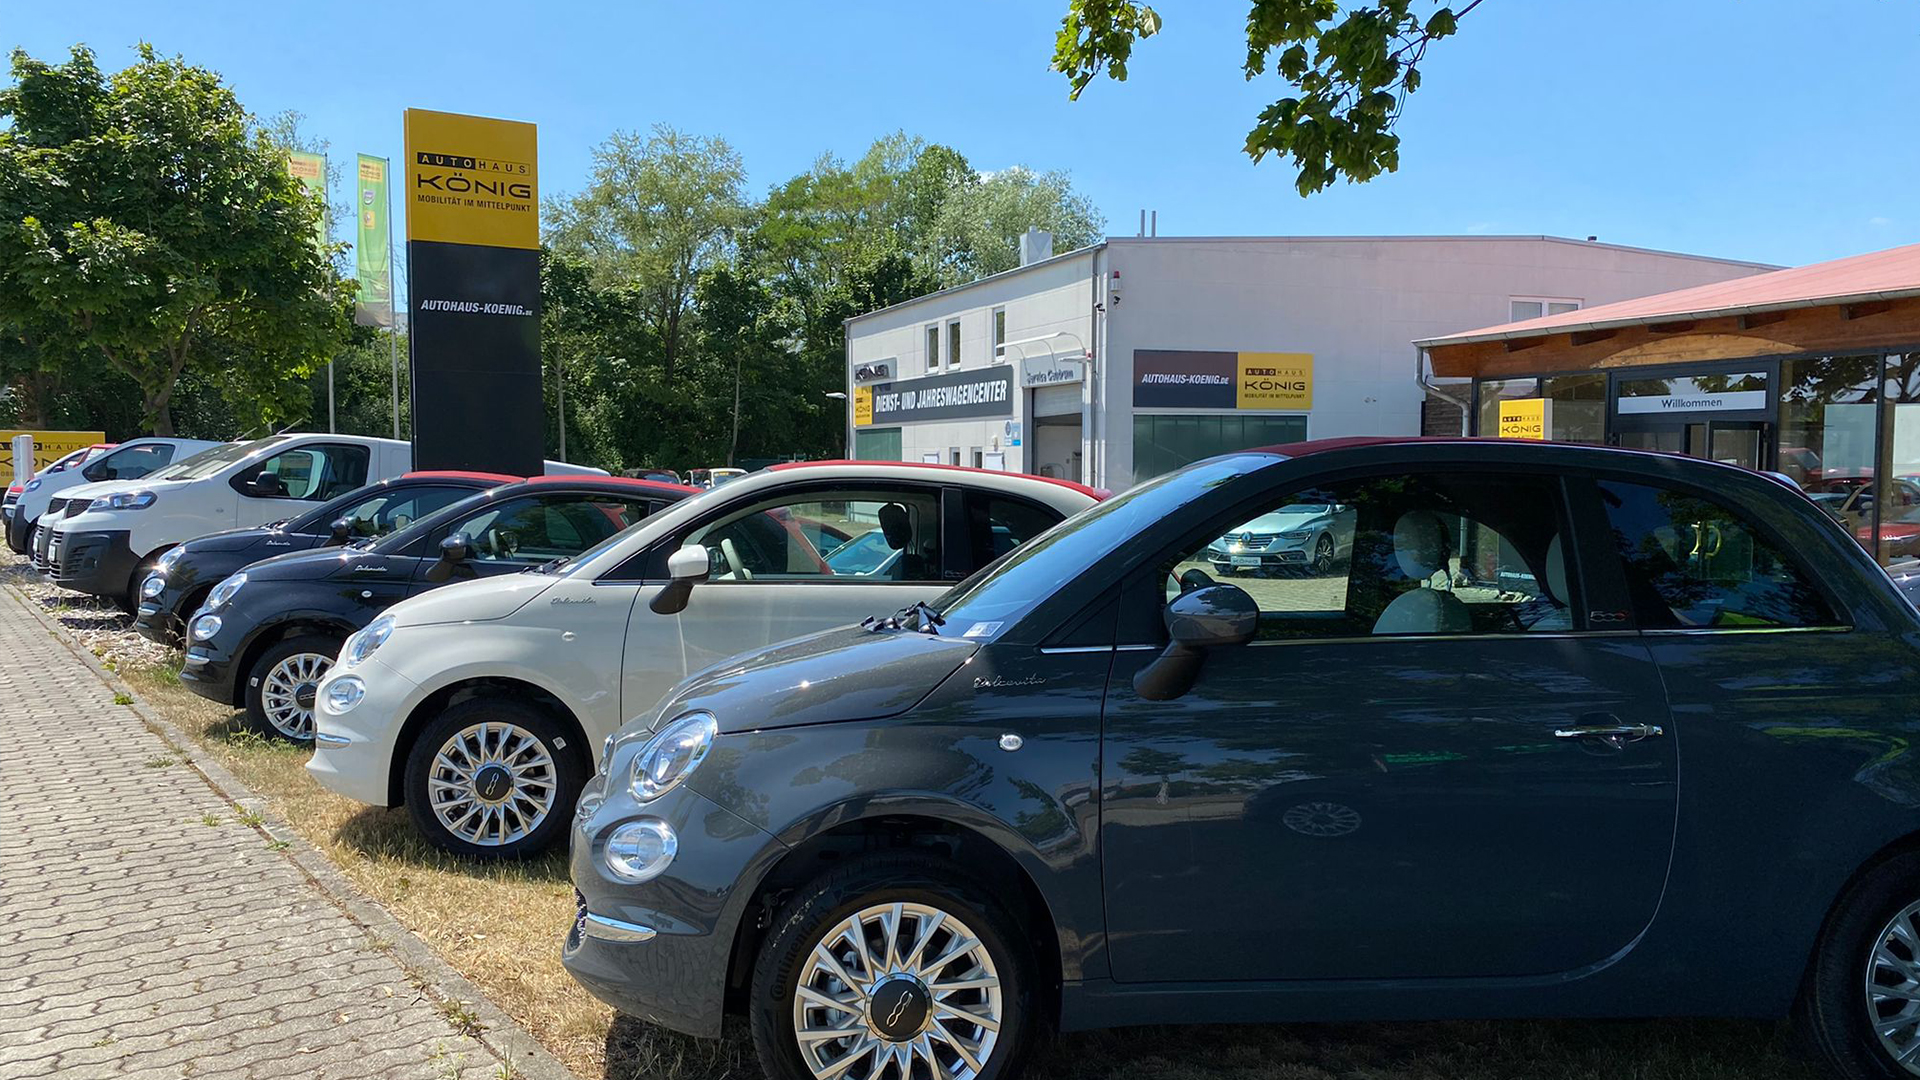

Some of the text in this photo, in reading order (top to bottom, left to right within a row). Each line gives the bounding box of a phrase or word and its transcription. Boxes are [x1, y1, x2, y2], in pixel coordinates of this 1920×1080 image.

[421, 154, 527, 174] AUTOHAUS
[417, 172, 531, 199] KÖNIG
[417, 194, 531, 213] MOBILITÄT IM MITTELPUNKT
[1244, 378, 1305, 391] KÖNIG
[875, 379, 1008, 413] DIENST- UND JAHRESWAGENCENTER
[1661, 398, 1723, 409] Willkommen
[1501, 424, 1541, 433] KÖNIG
